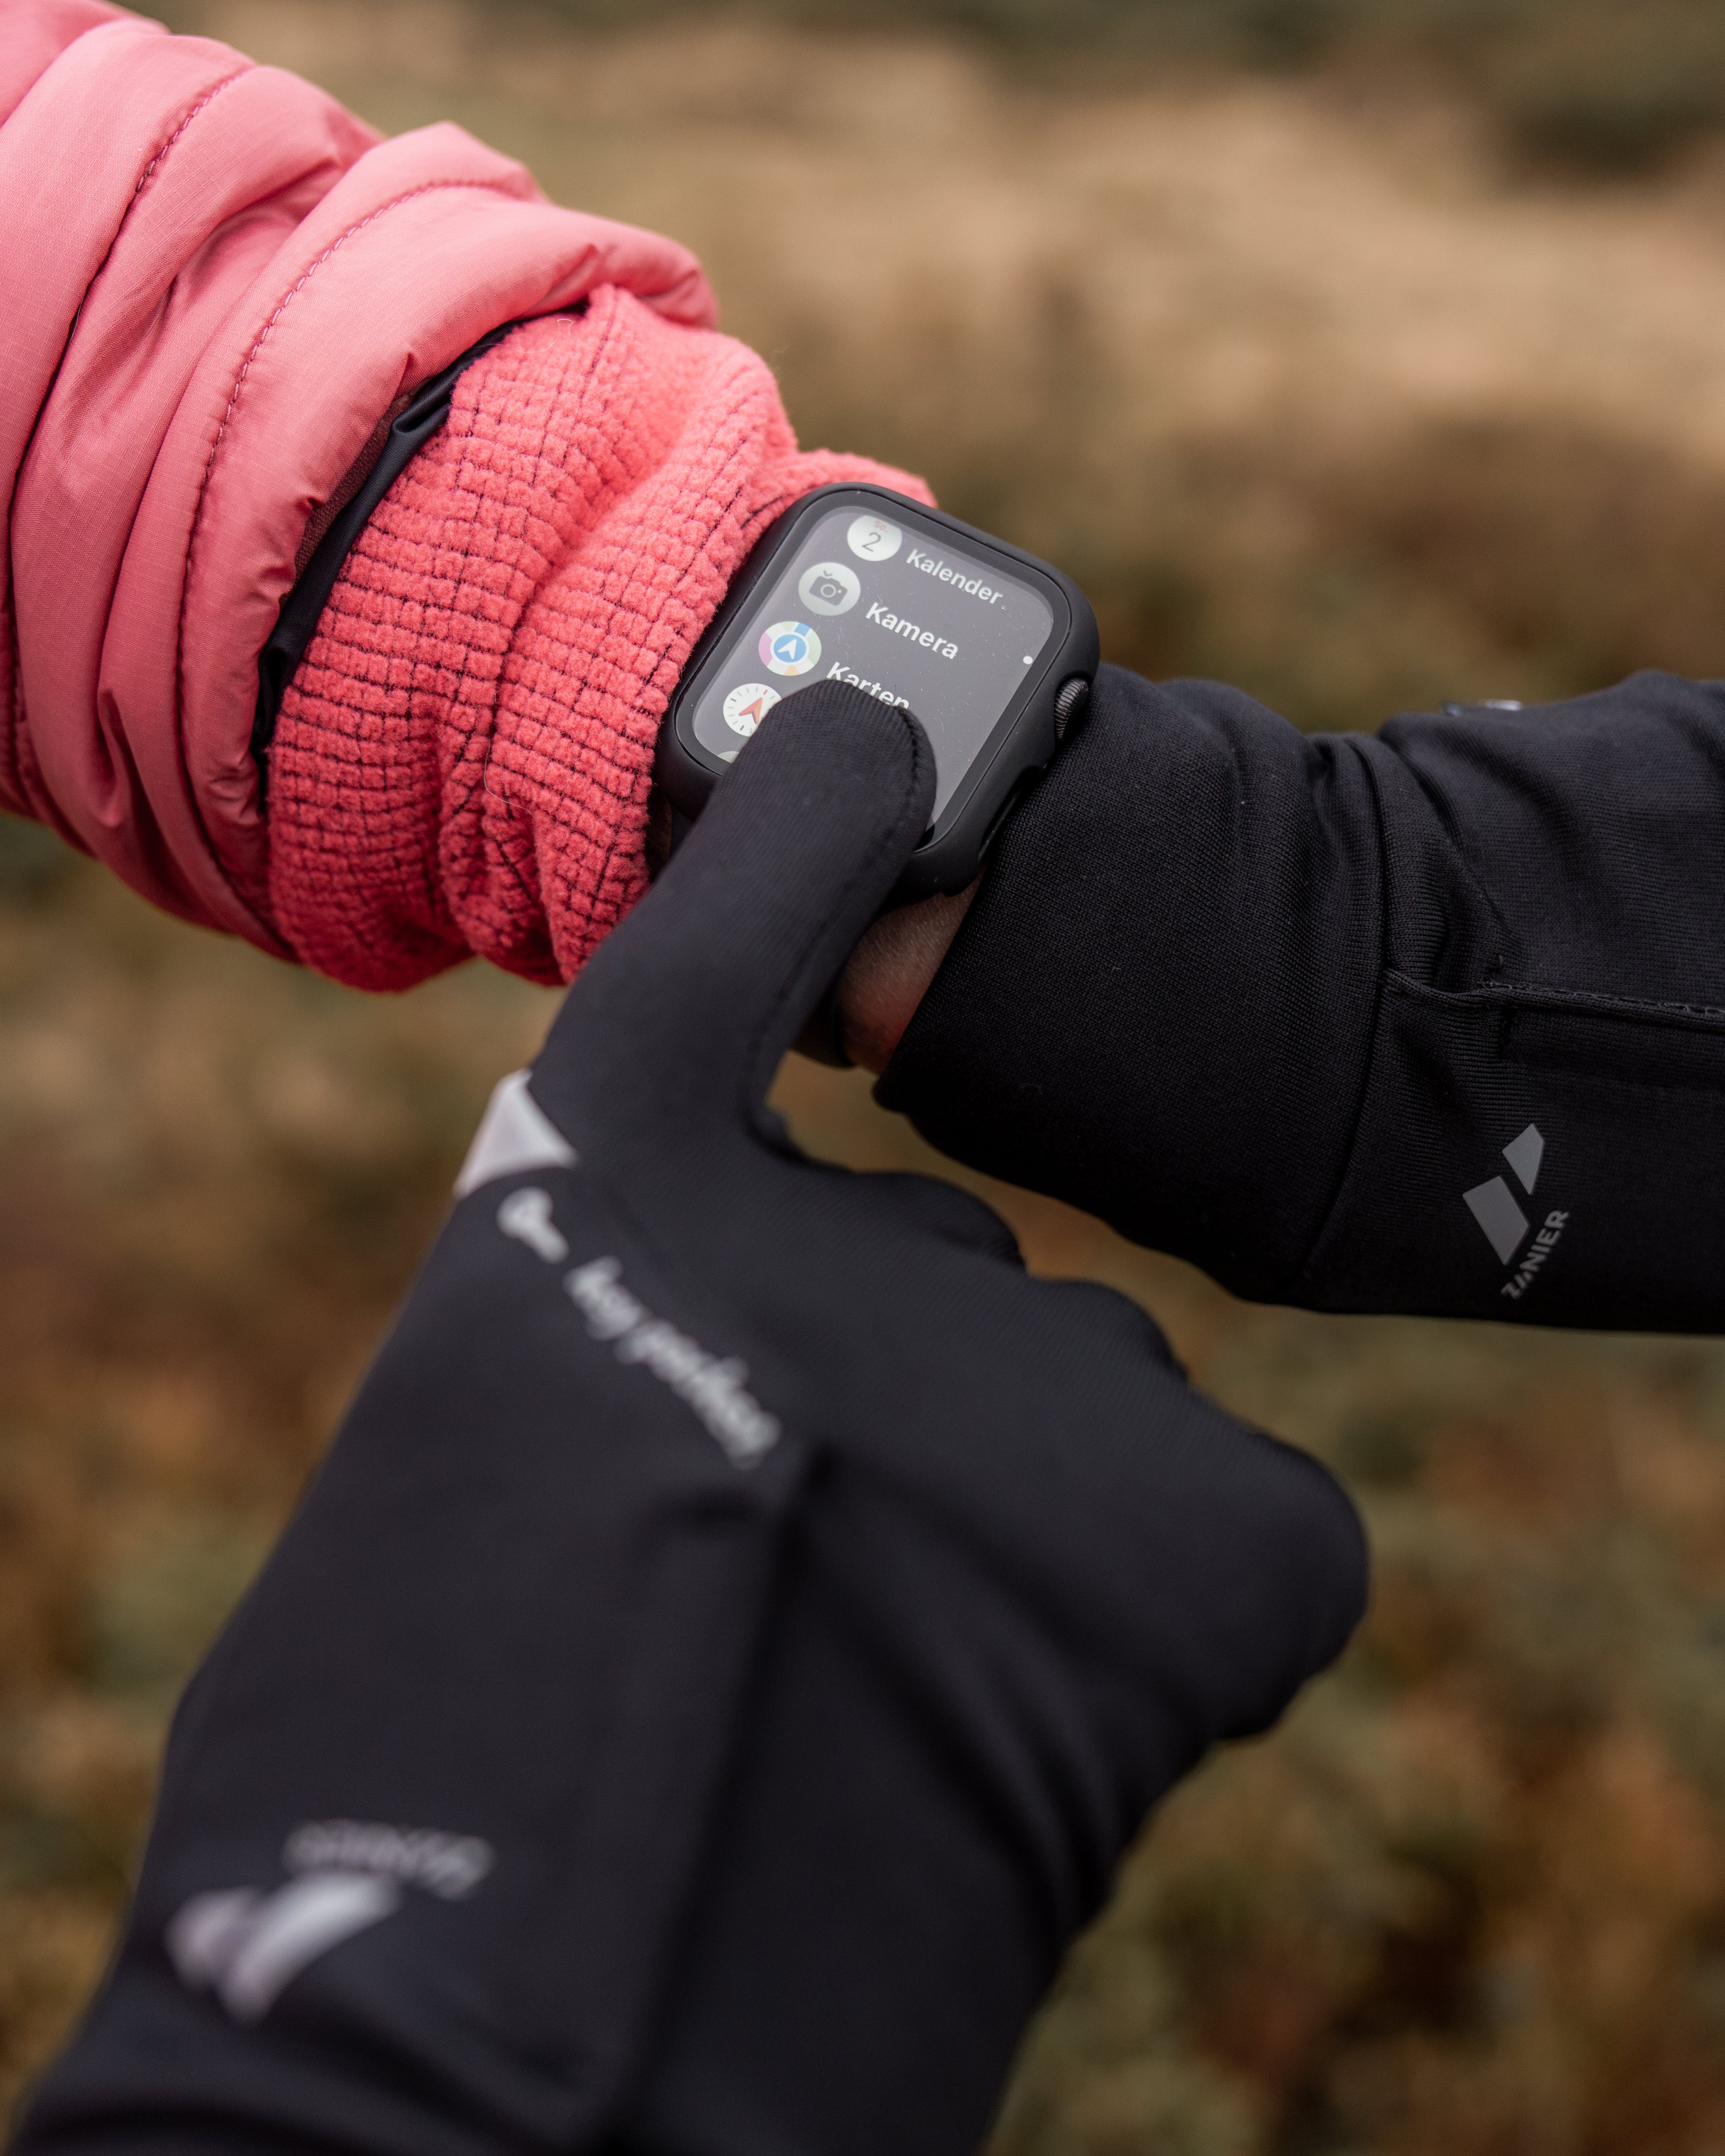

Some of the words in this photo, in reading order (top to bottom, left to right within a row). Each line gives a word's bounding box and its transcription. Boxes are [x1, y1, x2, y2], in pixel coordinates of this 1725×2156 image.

[862, 532, 881, 552] 2
[906, 549, 1004, 604] Kalender
[865, 602, 958, 659] Kamera
[826, 661, 909, 709] Karten
